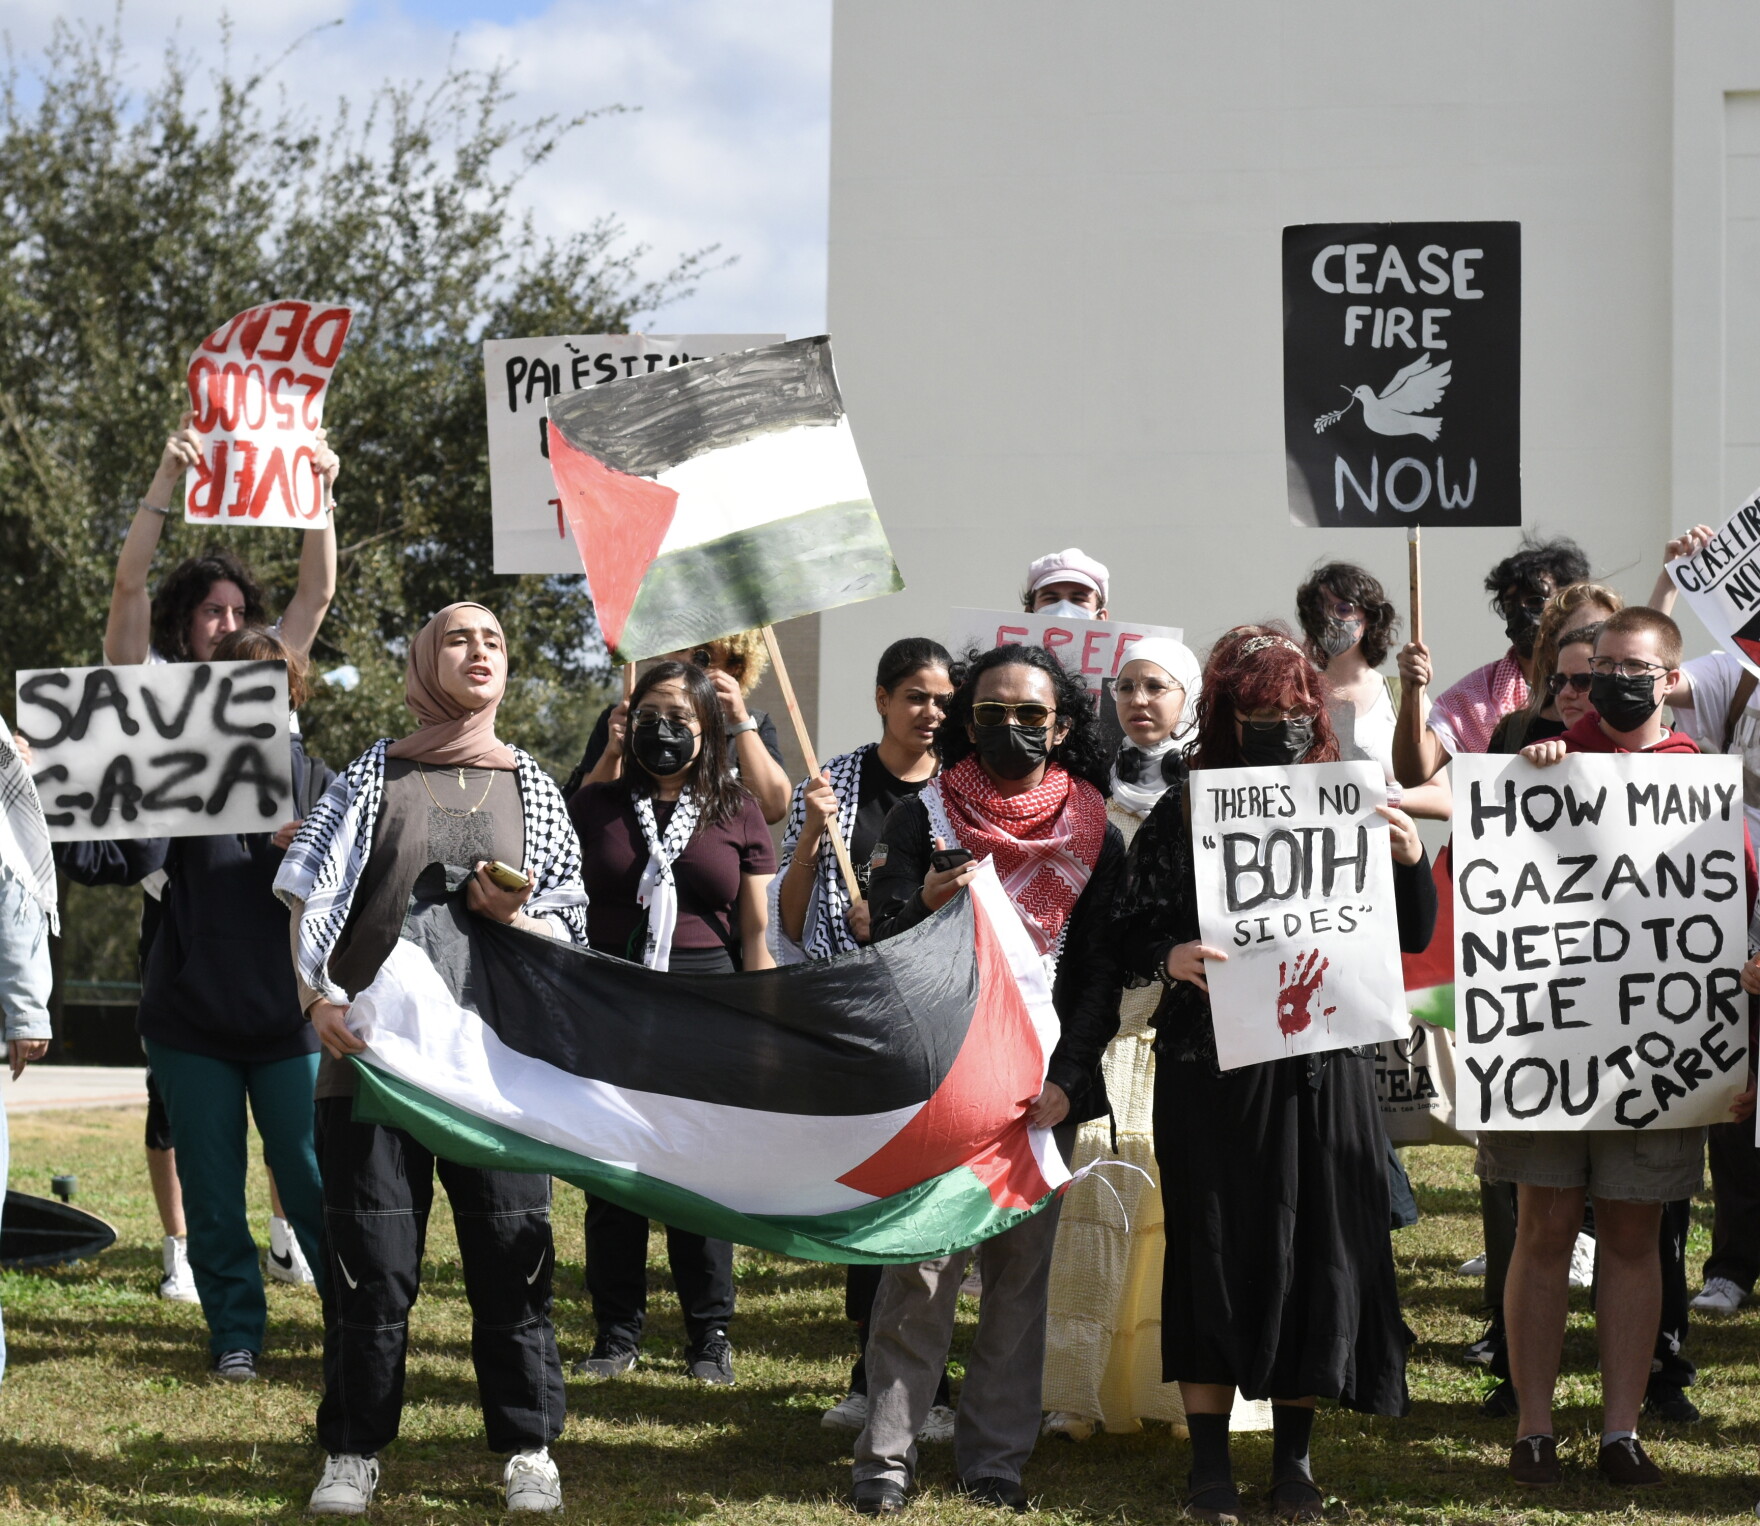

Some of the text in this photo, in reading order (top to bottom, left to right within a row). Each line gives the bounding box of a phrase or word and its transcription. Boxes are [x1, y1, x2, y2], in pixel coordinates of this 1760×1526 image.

[1311, 243, 1484, 300] CEASE
[1344, 306, 1451, 349] FIRE
[188, 440, 322, 520] OVER
[1334, 454, 1478, 518] NOW
[1676, 496, 1760, 592] CEASEFIR
[1725, 558, 1760, 611] NO
[19, 659, 287, 748] SAVE
[1207, 783, 1360, 822] THERE'S NO
[1471, 780, 1737, 839] HOW MANY
[1459, 850, 1738, 915] GAZANS
[1462, 914, 1723, 976] NEED TO
[1465, 967, 1743, 1044] DIE FOR
[1465, 1031, 1675, 1123] YOU TO
[1615, 1022, 1747, 1129] CARE
